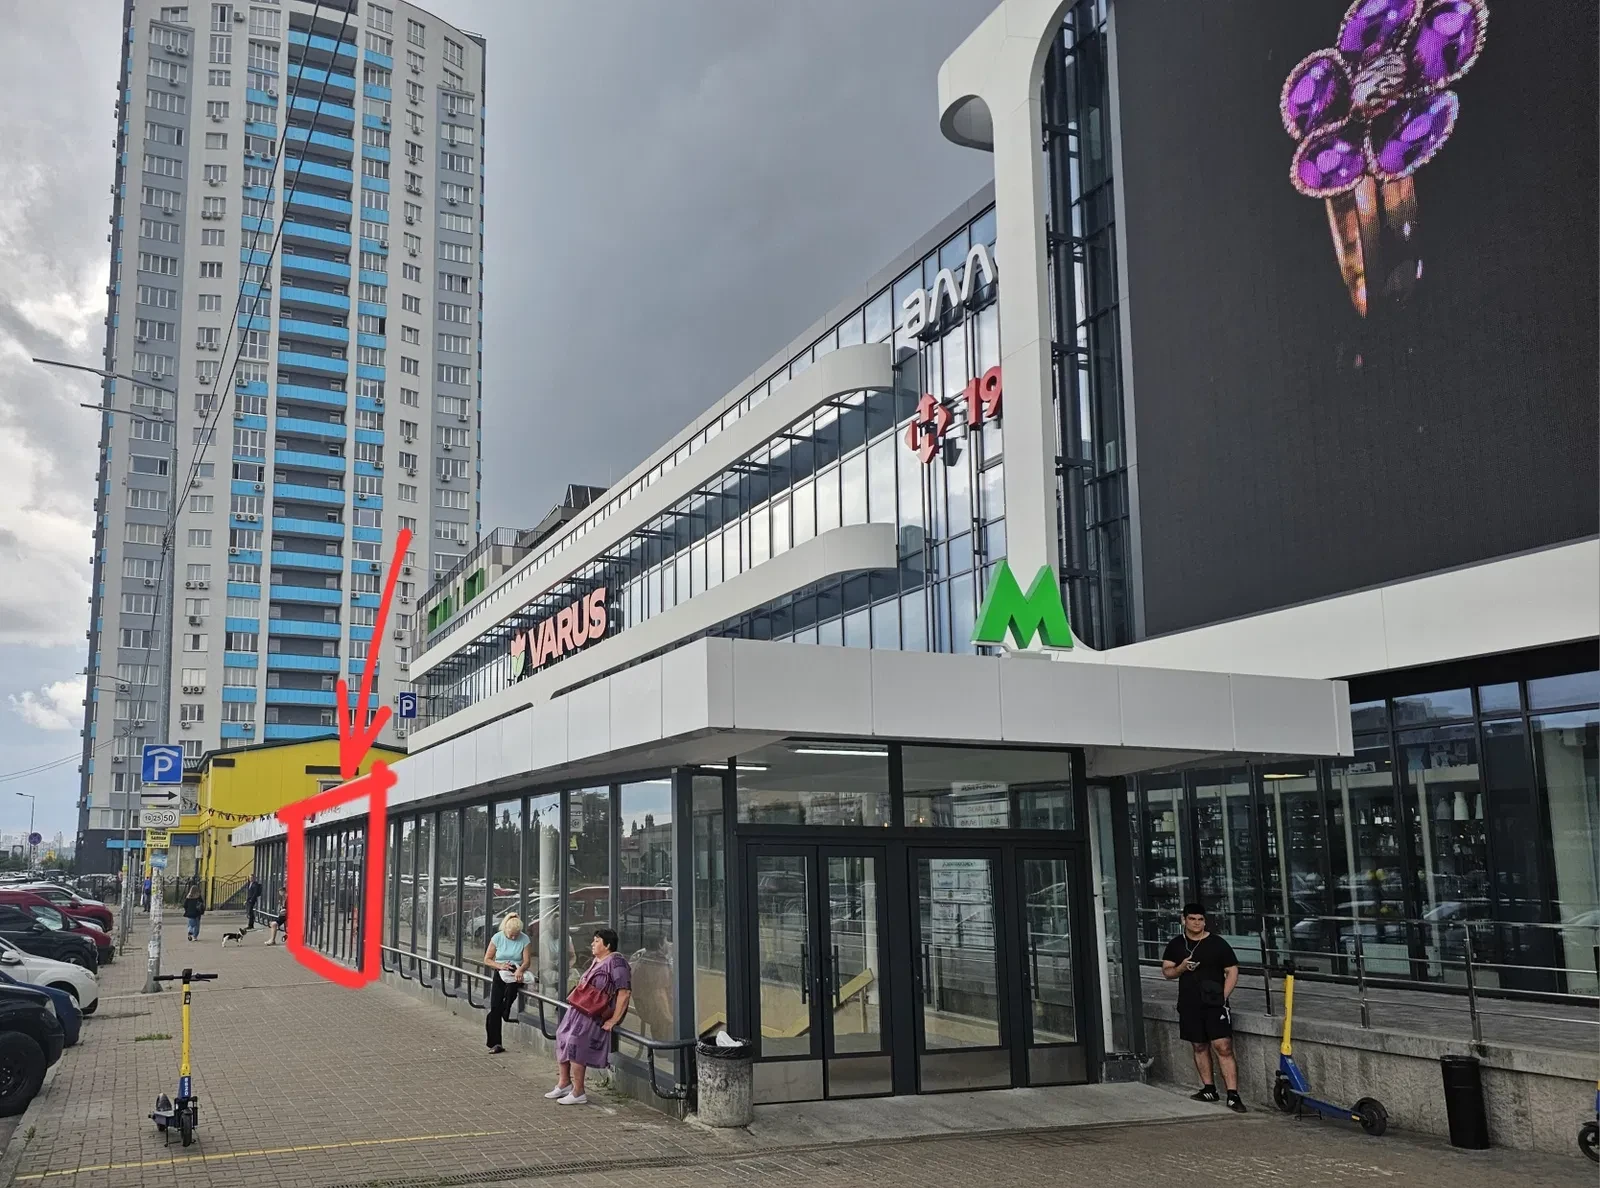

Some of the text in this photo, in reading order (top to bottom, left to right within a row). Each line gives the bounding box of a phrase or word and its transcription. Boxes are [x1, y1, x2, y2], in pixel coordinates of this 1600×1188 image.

[903, 243, 999, 339] алл
[528, 587, 606, 668] VARUS
[402, 699, 413, 716] P
[154, 755, 172, 780] P
[163, 814, 173, 822] 50
